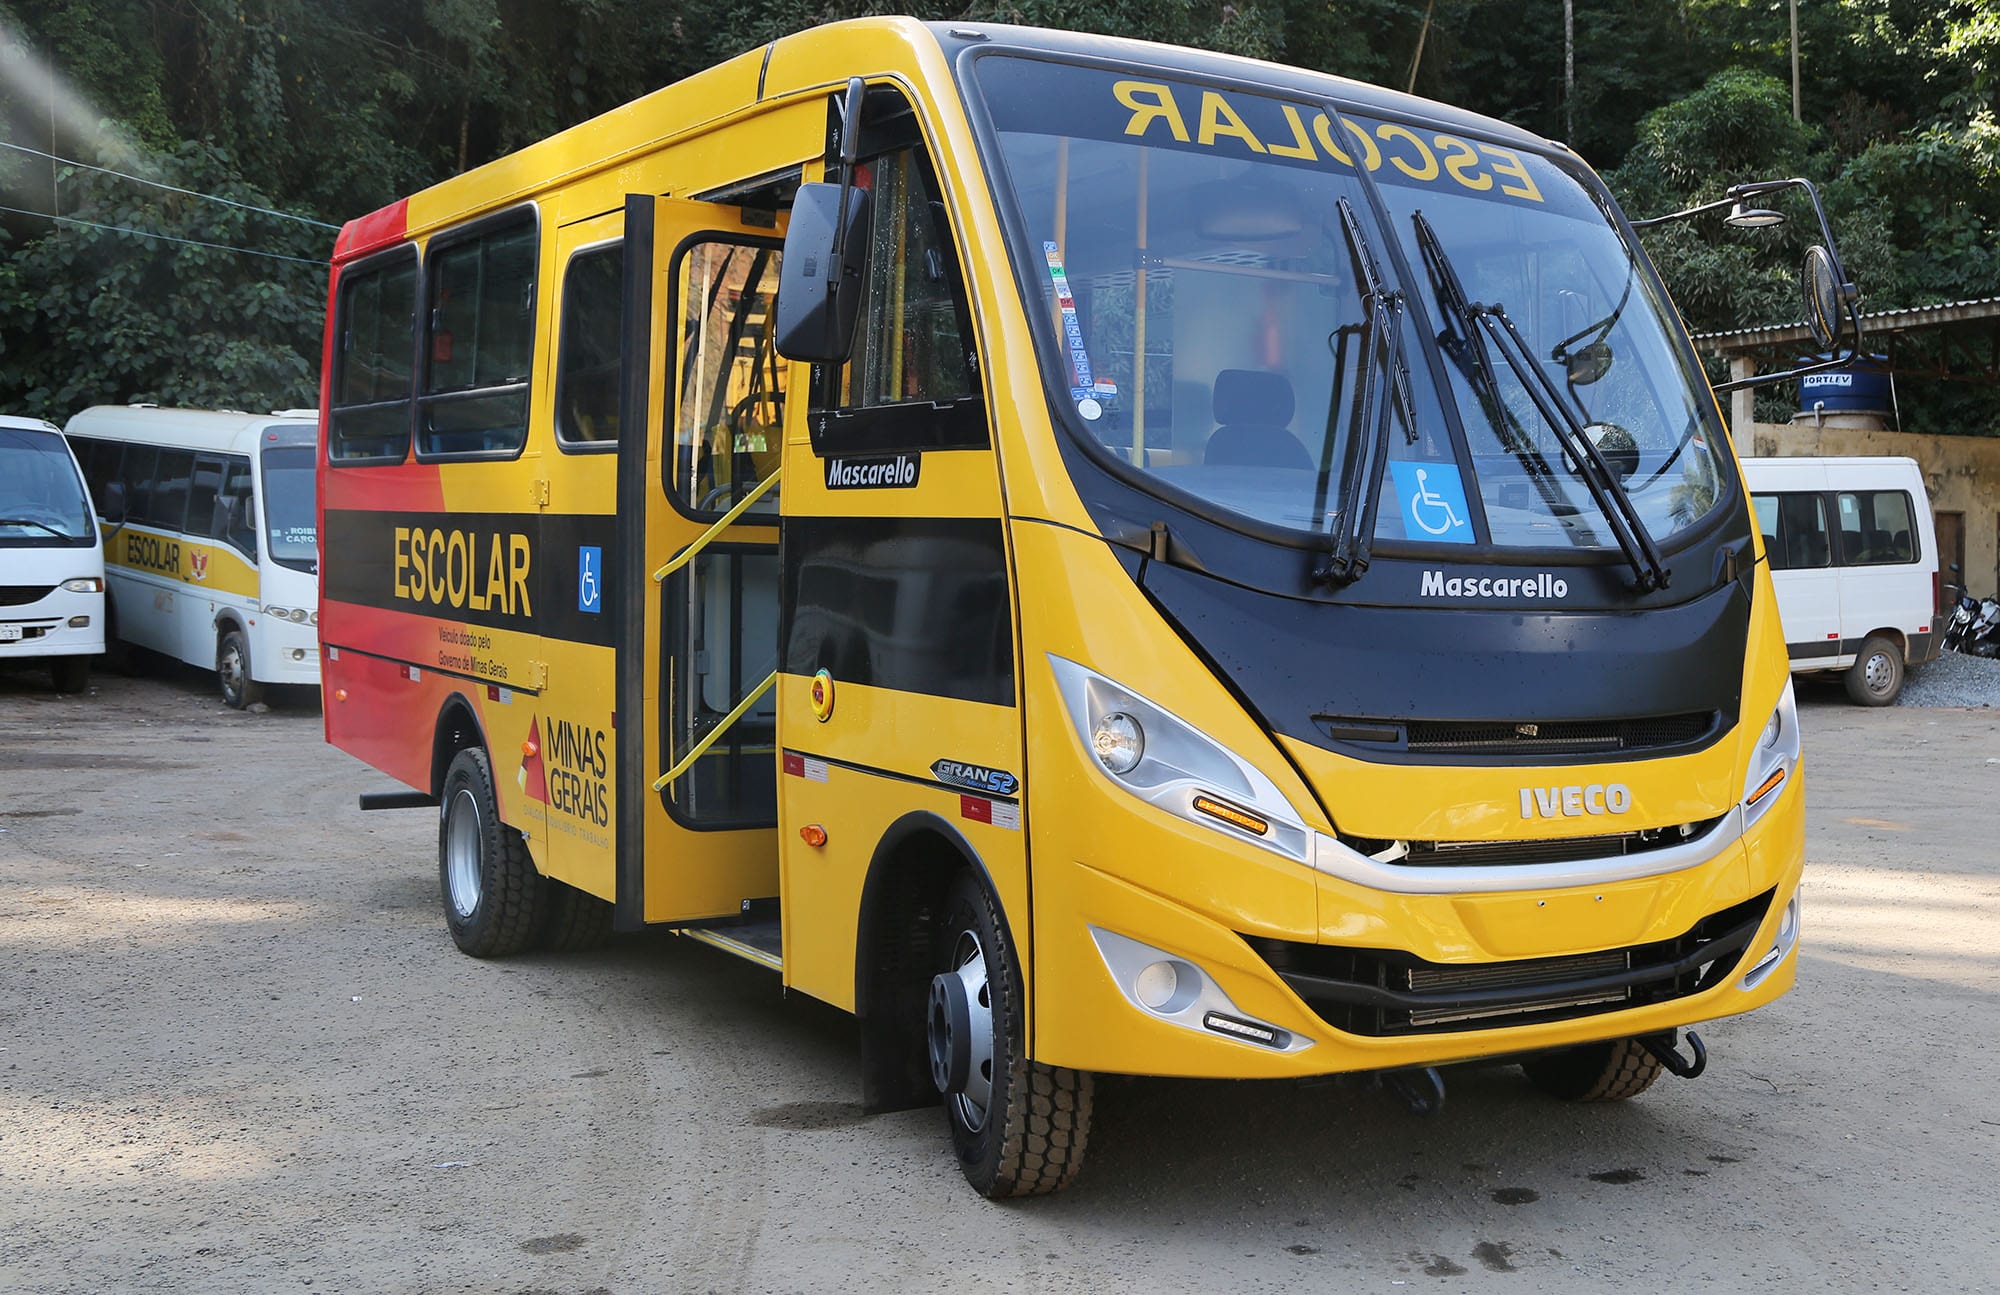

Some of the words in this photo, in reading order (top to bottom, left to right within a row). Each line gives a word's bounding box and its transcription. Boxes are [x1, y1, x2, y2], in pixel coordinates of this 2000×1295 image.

[828, 456, 915, 486] Mascarello
[127, 534, 180, 574] ESCOLAR
[394, 527, 532, 617] ESCOLAR
[1420, 571, 1568, 599] Mascarello
[459, 629, 477, 648] doado
[478, 633, 491, 652] pelo
[438, 650, 461, 669] Governo
[462, 655, 470, 671] de
[470, 656, 488, 674] Minas
[488, 659, 507, 679] Gerais
[547, 716, 606, 780] MINAS
[938, 761, 989, 782] GRAN
[550, 768, 609, 828] GERAIS
[1520, 783, 1631, 819] IVECO
